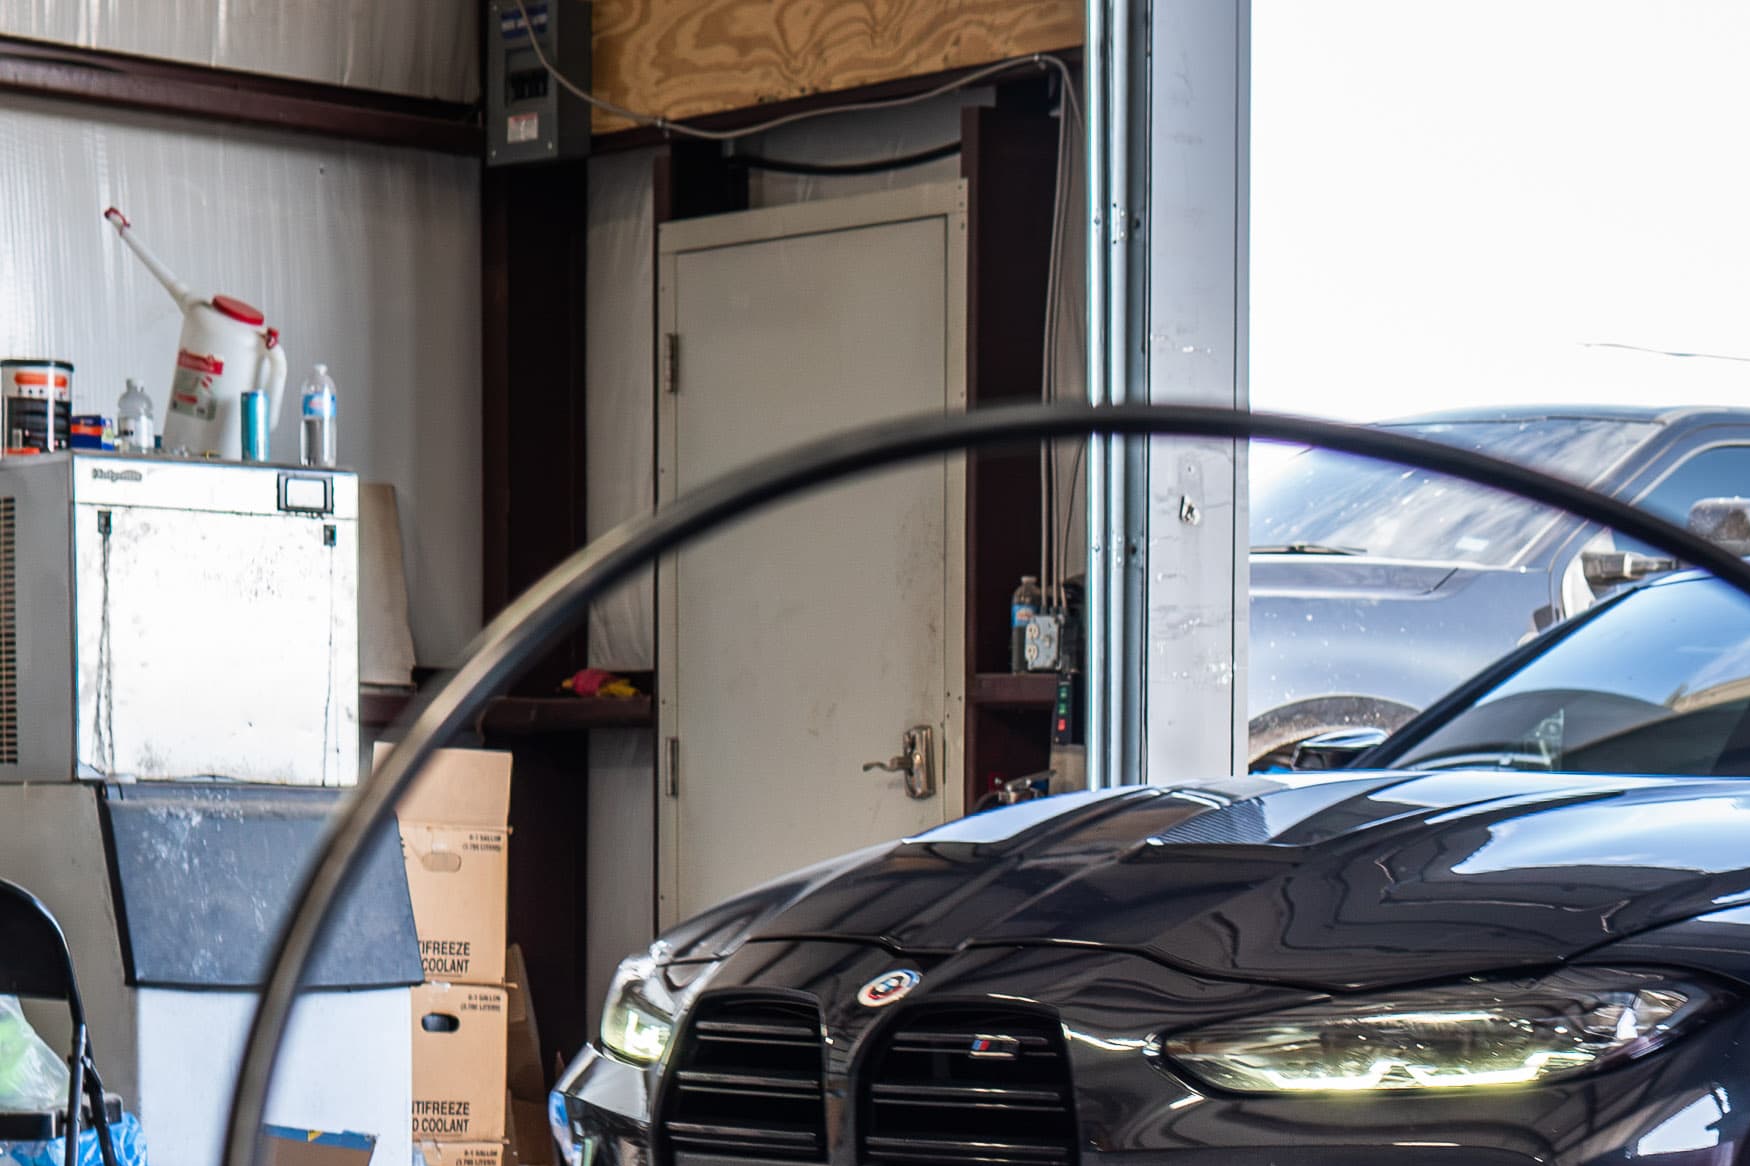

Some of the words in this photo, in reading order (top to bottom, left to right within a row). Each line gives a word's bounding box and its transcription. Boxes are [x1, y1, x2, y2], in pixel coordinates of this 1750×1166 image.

[418, 940, 471, 956] IFREEZE
[421, 958, 470, 974] COOLANT
[421, 1118, 470, 1133] COOLANT
